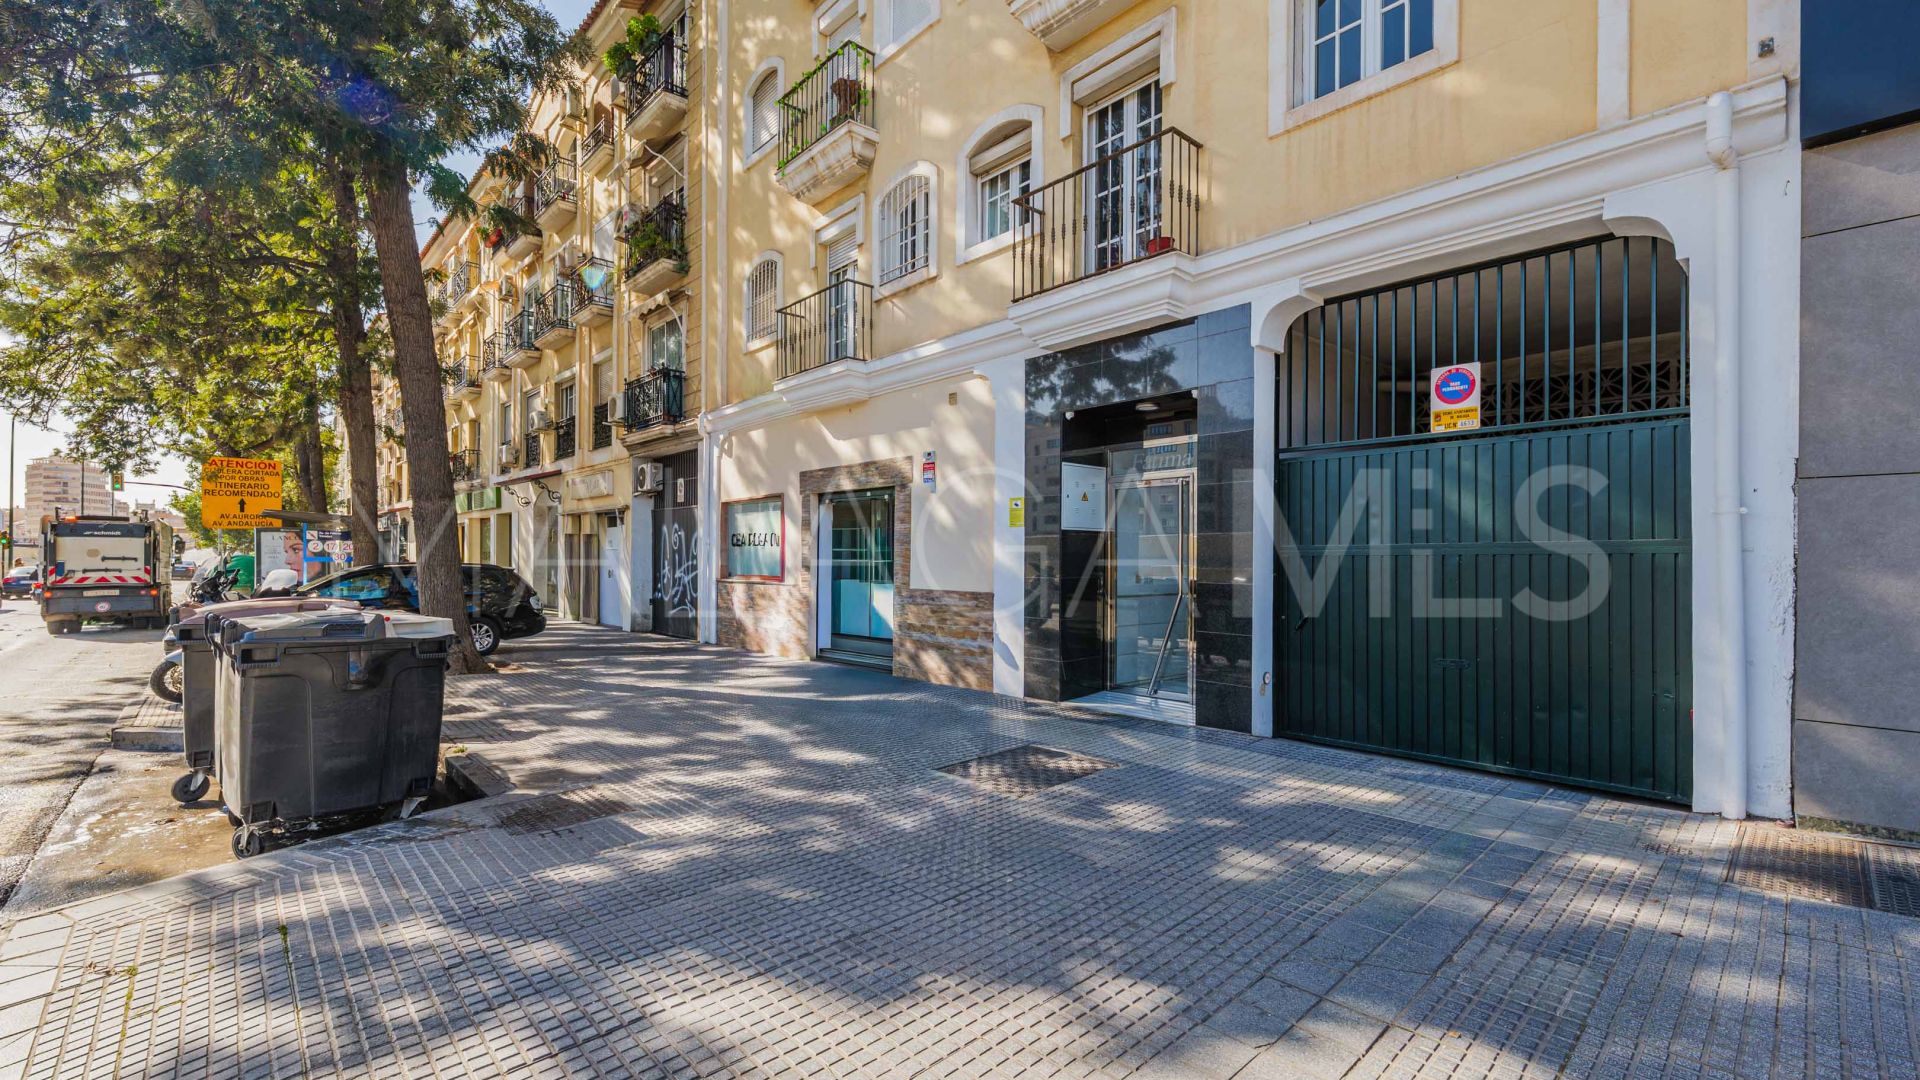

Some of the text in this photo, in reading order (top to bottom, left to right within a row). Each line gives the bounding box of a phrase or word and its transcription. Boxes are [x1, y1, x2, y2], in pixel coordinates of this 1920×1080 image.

[244, 469, 280, 477] CORTADA
[215, 482, 270, 490] ITINERARIO
[204, 489, 280, 498] RECOMENDADO
